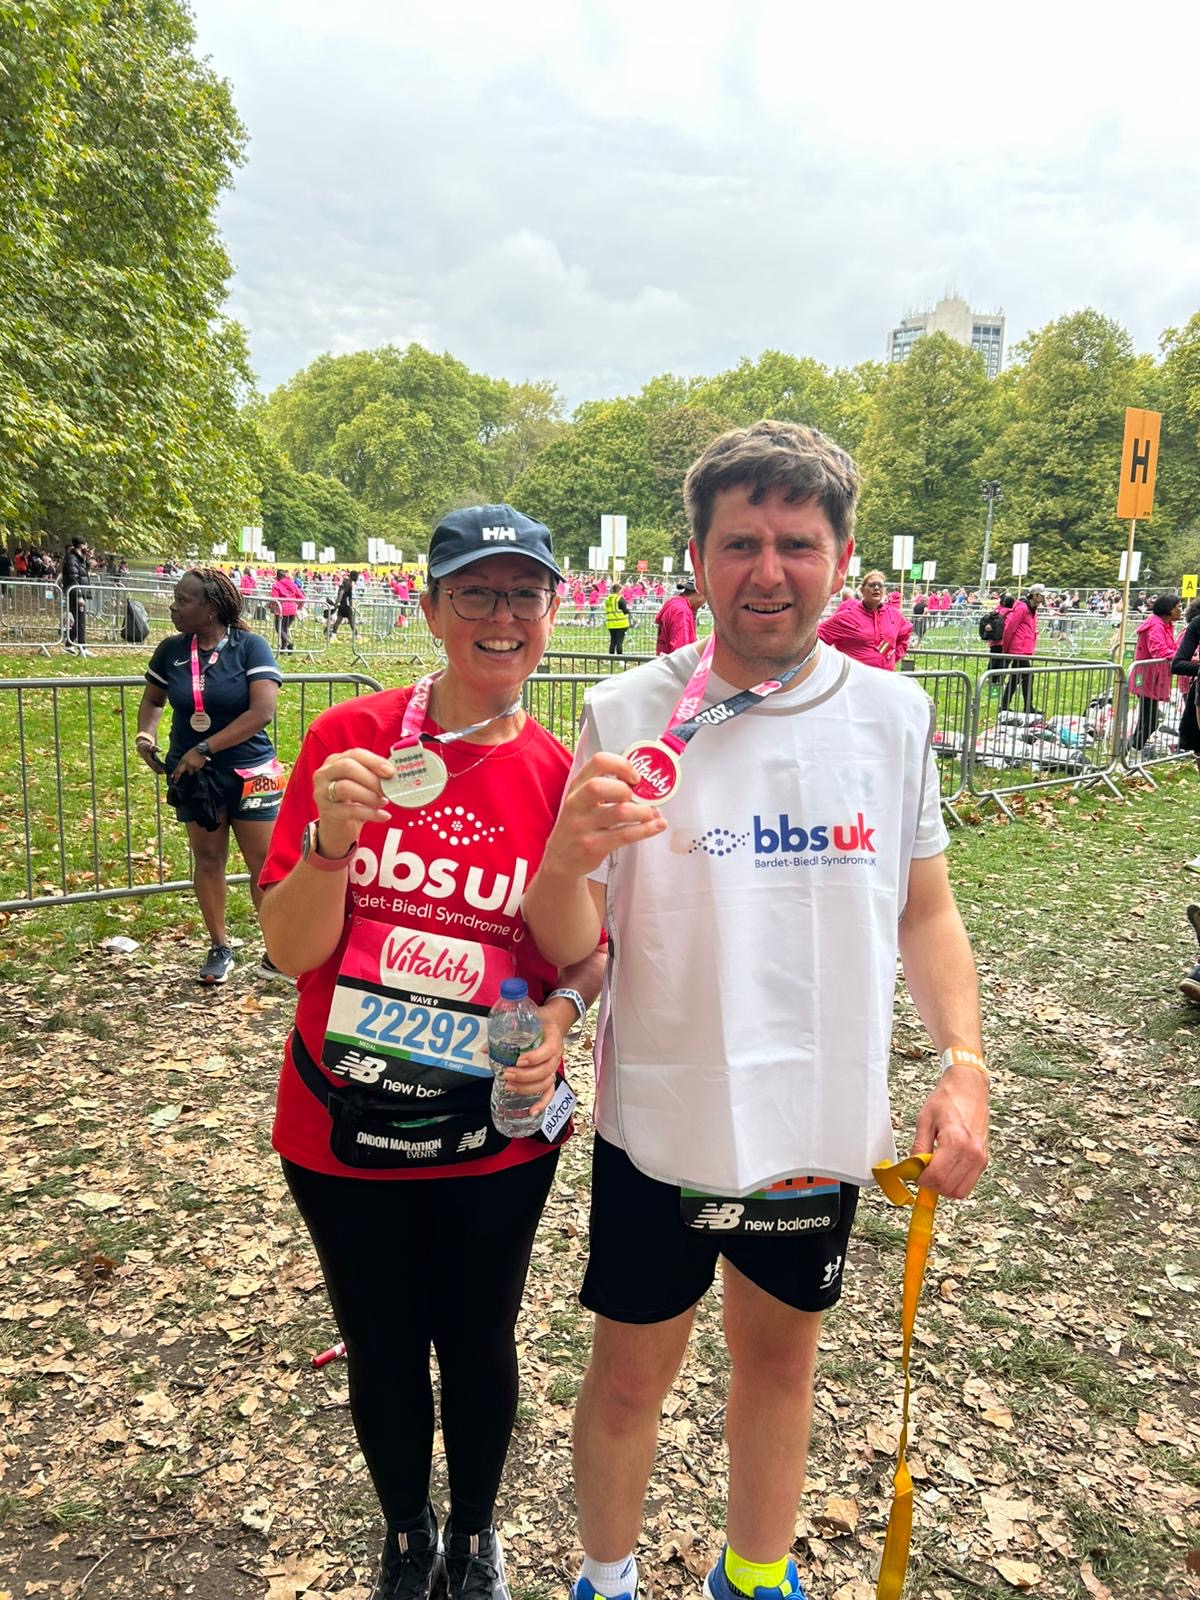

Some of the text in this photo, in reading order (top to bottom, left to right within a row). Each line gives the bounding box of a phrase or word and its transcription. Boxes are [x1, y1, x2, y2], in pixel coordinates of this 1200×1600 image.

[1130, 438, 1151, 484] H
[482, 526, 516, 541] HH
[1185, 580, 1194, 591] A
[627, 750, 671, 797] Vitality
[753, 812, 876, 854] bbs uk
[755, 856, 819, 868] Bardet-Biedl
[352, 891, 433, 918] Bdet-Biedl
[435, 906, 511, 936] Syndrome
[386, 935, 480, 996] Vitality
[410, 994, 433, 1006] WAVE
[355, 995, 481, 1061] 22292
[382, 1078, 414, 1095] new
[545, 1092, 573, 1134] BUXTON
[356, 1131, 442, 1152] ONDON MARATHON
[406, 1150, 438, 1159] EVENTS
[744, 1220, 775, 1231] new
[777, 1215, 831, 1232] balance
